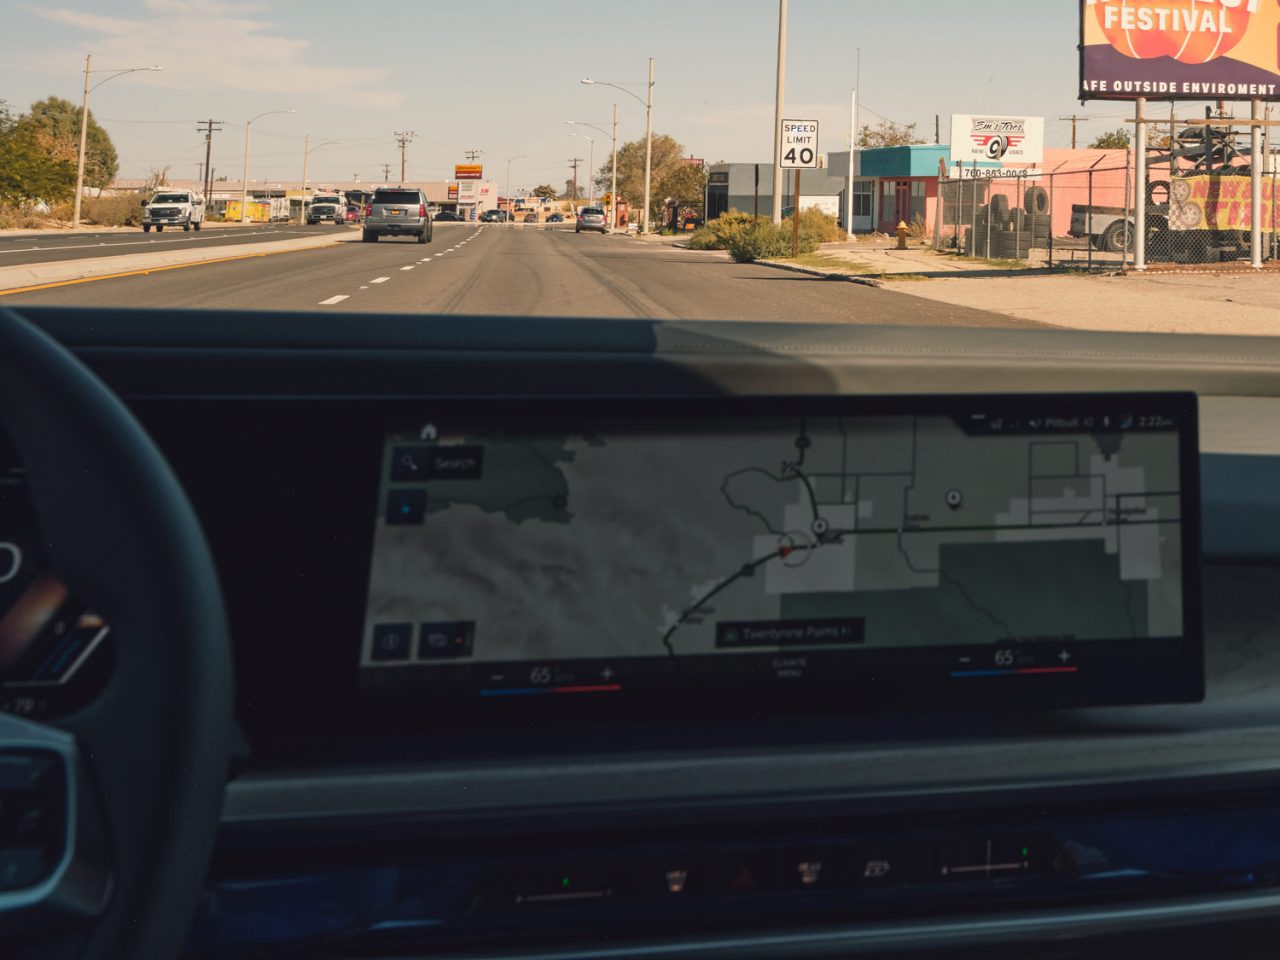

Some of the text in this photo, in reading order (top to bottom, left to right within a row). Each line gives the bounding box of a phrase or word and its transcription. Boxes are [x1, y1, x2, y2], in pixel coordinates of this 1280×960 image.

[1104, 6, 1233, 33] FESTIVAL
[1113, 80, 1177, 93] OUTSIDE
[1182, 82, 1276, 95] ENVIROMENT
[784, 124, 816, 133] SPEED
[1001, 121, 1023, 132] Tires
[786, 136, 812, 144] LIMIT
[784, 147, 814, 164] 40
[1191, 179, 1241, 199] NEW
[993, 649, 1014, 666] 65
[530, 666, 551, 684] 65
